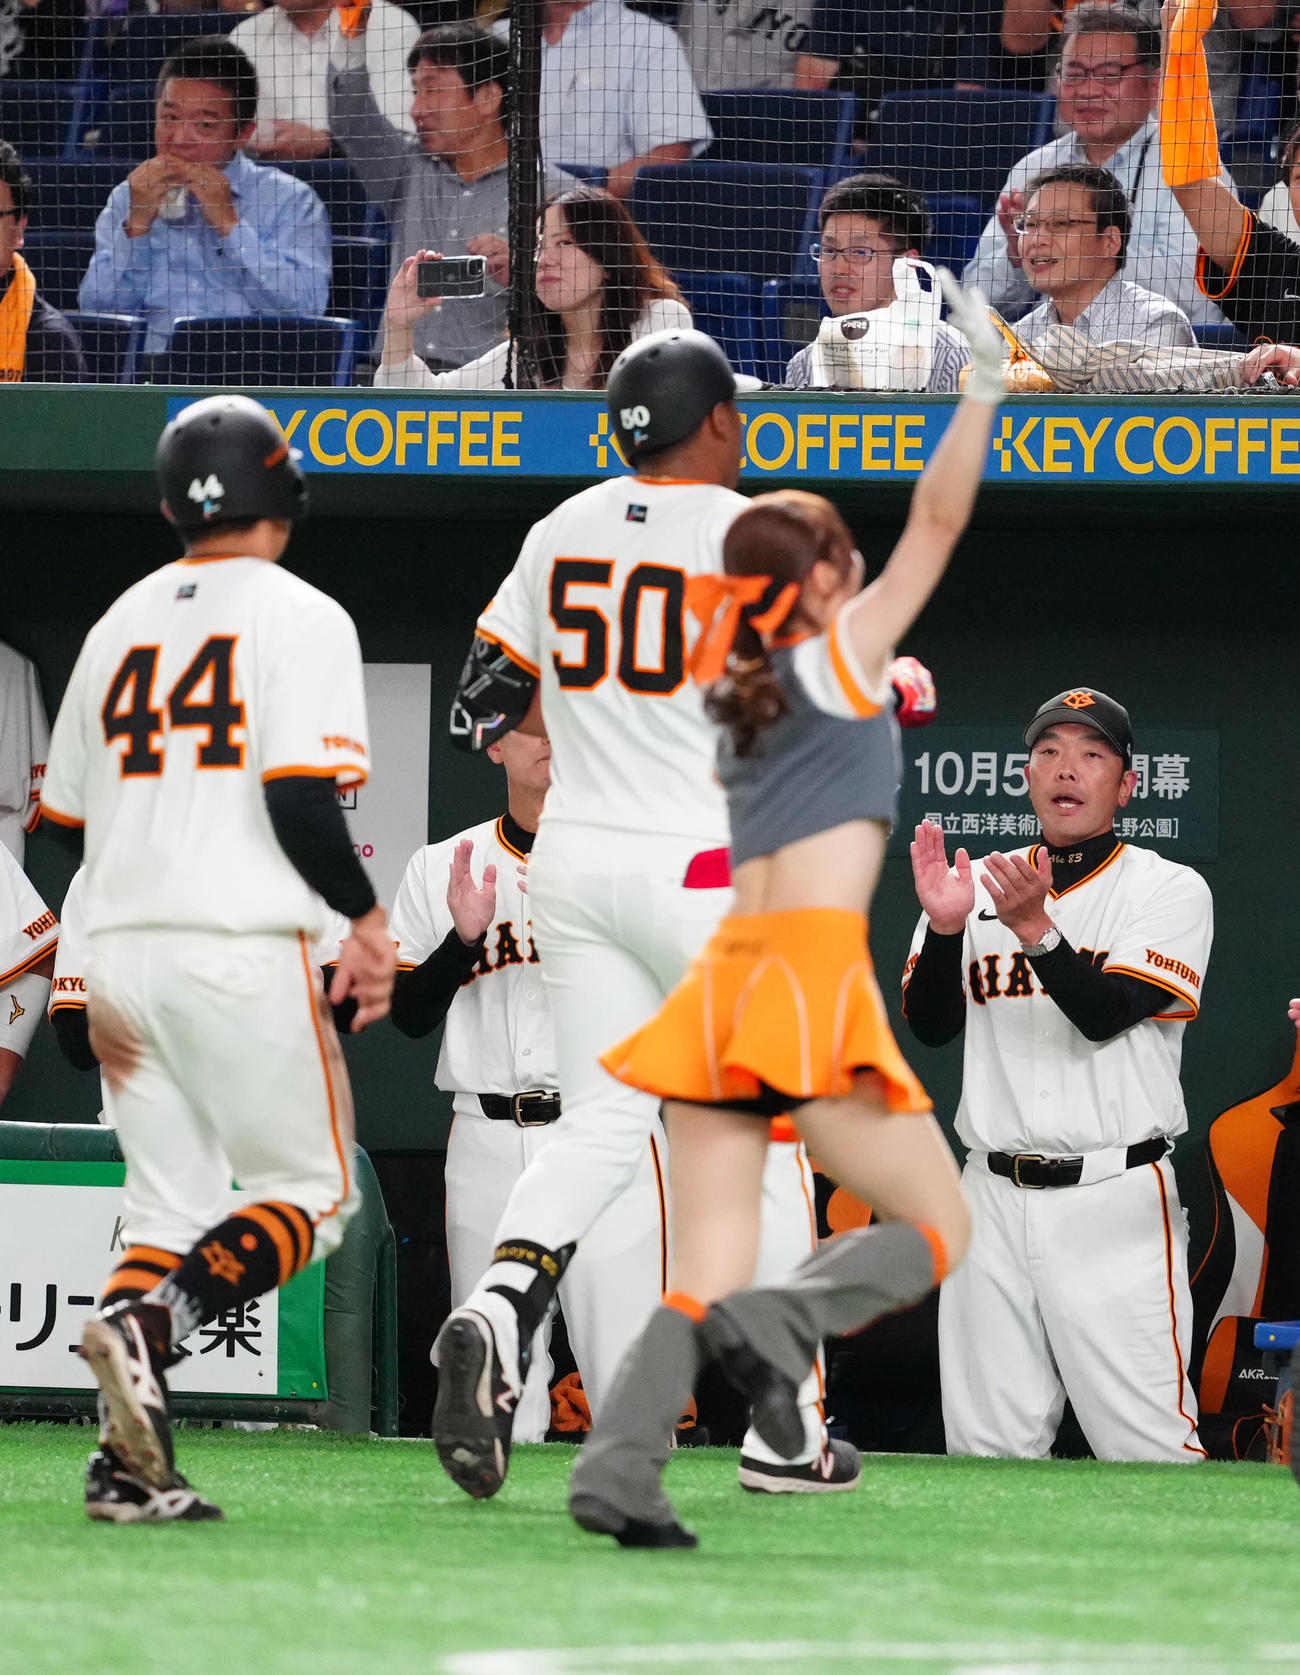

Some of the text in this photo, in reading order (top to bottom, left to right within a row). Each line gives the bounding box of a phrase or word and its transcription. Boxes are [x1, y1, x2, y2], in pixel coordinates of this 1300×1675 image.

[620, 405, 651, 430] 50
[738, 412, 925, 470] OFFEE
[187, 473, 225, 503] 44
[548, 557, 689, 696] 50
[102, 634, 246, 779] 44
[1068, 852, 1083, 863] 83
